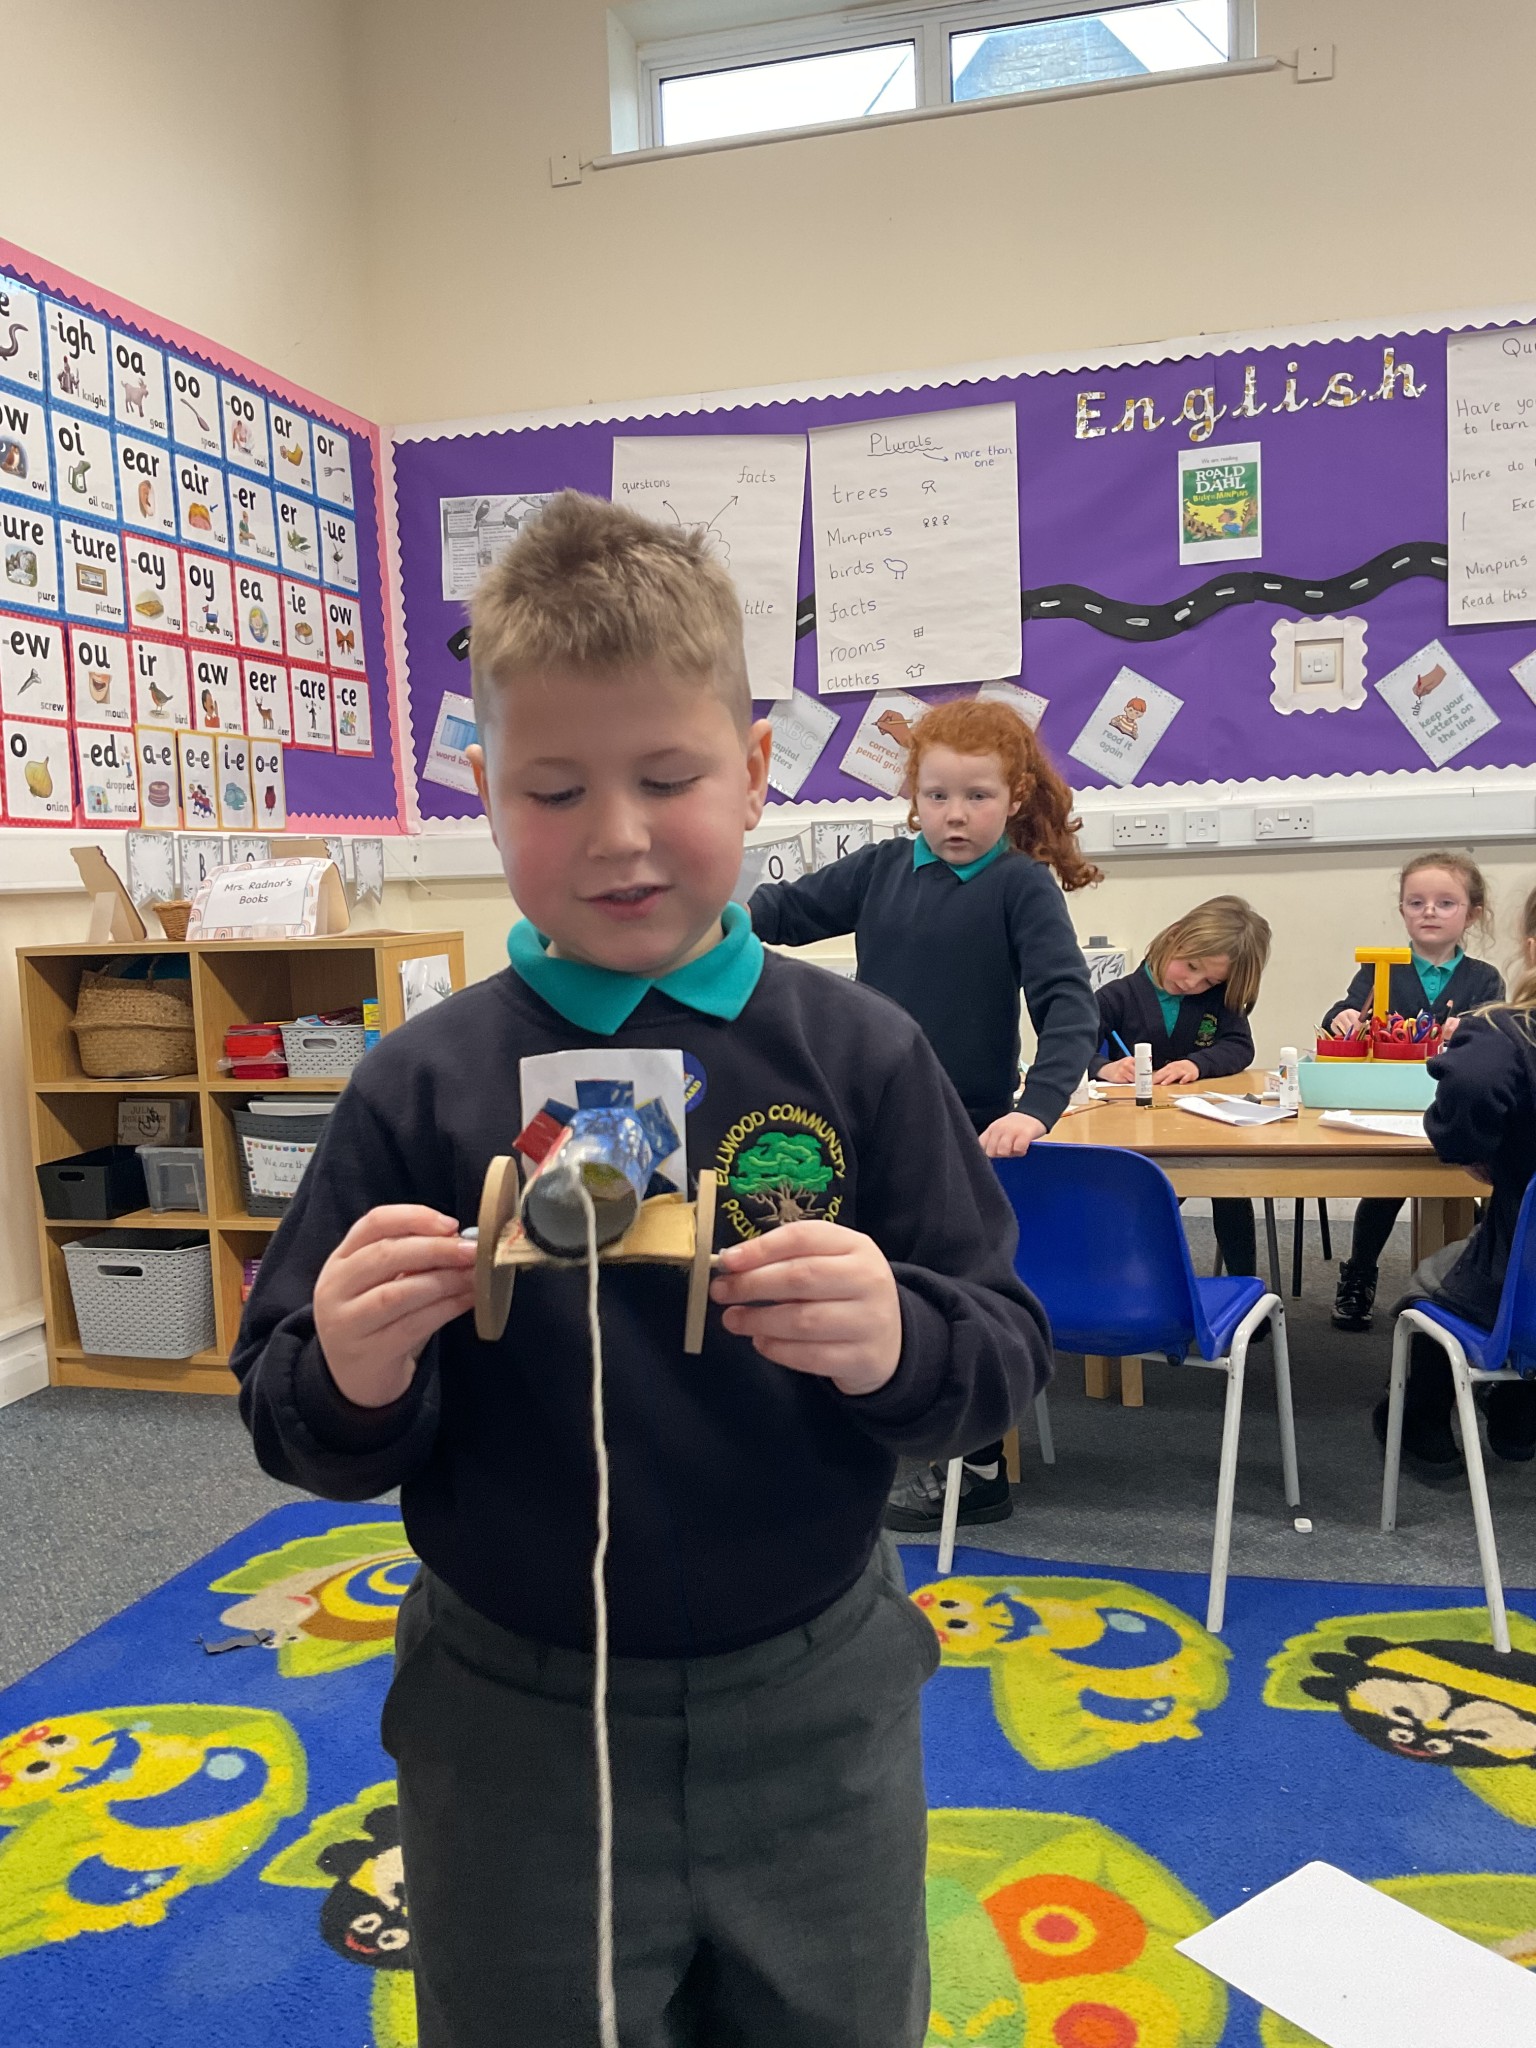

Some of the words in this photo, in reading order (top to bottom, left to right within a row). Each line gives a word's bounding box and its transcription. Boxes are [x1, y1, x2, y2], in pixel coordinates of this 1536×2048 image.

[51, 312, 96, 359] -igh
[1502, 338, 1536, 358] Qu
[116, 345, 146, 377] oa
[28, 369, 40, 382] eel
[174, 370, 200, 399] oo
[82, 388, 107, 409] knight
[1074, 347, 1427, 442] English
[1456, 399, 1500, 417] Have
[1517, 399, 1536, 415] yo
[149, 418, 166, 431] goat
[273, 415, 292, 439] ar
[1464, 422, 1478, 435] to
[1491, 419, 1528, 432] learn
[58, 422, 85, 456] oi
[316, 434, 335, 457] or
[869, 432, 933, 455] Plurals
[122, 447, 159, 478] ear
[954, 449, 981, 461] more
[988, 445, 1013, 457] than
[974, 457, 995, 468] one
[181, 464, 209, 496] air
[736, 465, 776, 485] facts
[1195, 465, 1246, 481] ROALD
[1450, 469, 1491, 484] Where
[1508, 461, 1524, 472] do
[32, 480, 48, 493] owl
[622, 478, 671, 494] questions
[833, 484, 888, 504] trees
[1195, 476, 1246, 494] DAHL
[88, 495, 99, 507] oil
[100, 500, 114, 512] can
[280, 503, 297, 524] er
[0, 514, 44, 546] ure
[163, 517, 174, 529] ear
[65, 528, 117, 562] -ture
[827, 526, 893, 546] Minpins
[131, 551, 166, 589] -ay
[829, 560, 875, 580] birds
[1466, 555, 1528, 579] Minpins
[189, 564, 215, 602] oy
[240, 578, 264, 602] ea
[37, 591, 56, 603] pure
[744, 600, 774, 615] title
[1462, 593, 1495, 610] Read
[1503, 588, 1528, 603] this
[95, 601, 122, 616] picture
[329, 603, 352, 626] ow
[829, 598, 877, 622] facts
[167, 615, 181, 630] tray
[2, 630, 51, 660] -ew
[223, 628, 234, 643] toy
[78, 641, 111, 669] ou
[138, 644, 157, 677] ir
[830, 638, 886, 662] rooms
[198, 662, 228, 686] aw
[249, 670, 277, 694] eer
[827, 673, 880, 691] clothes
[294, 679, 326, 701] -are
[336, 687, 357, 707] -ce
[40, 700, 65, 713] screw
[105, 708, 129, 720] mouth
[1419, 711, 1441, 729] keep
[1443, 694, 1465, 715] your
[174, 712, 189, 725] bird
[224, 720, 242, 733] yawn
[1425, 713, 1459, 738] letters
[1460, 703, 1474, 714] on
[1438, 729, 1457, 744] the
[1457, 715, 1476, 731] line
[773, 714, 818, 750] ABC
[1102, 729, 1123, 745] read
[1124, 737, 1133, 751] it
[10, 733, 28, 758] o
[83, 734, 120, 768] -ed
[143, 743, 172, 767] a-e
[772, 740, 801, 761] capital
[869, 740, 899, 760] correct
[1100, 741, 1123, 759] again
[186, 747, 210, 769] e-e
[224, 744, 245, 772] i-e
[255, 754, 279, 773] o-e
[436, 750, 457, 762] word
[458, 756, 473, 768] ban
[855, 746, 883, 763] pencil
[883, 759, 901, 775] grip
[106, 780, 136, 793] dropped
[46, 801, 70, 813] onion
[114, 802, 137, 814] rained
[836, 834, 851, 859] K
[224, 883, 245, 892] Mrs.
[248, 878, 293, 890] Radnor's
[239, 895, 269, 905] Books
[768, 1103, 846, 1179] COMMUNITY
[822, 1195, 843, 1223] OOL
